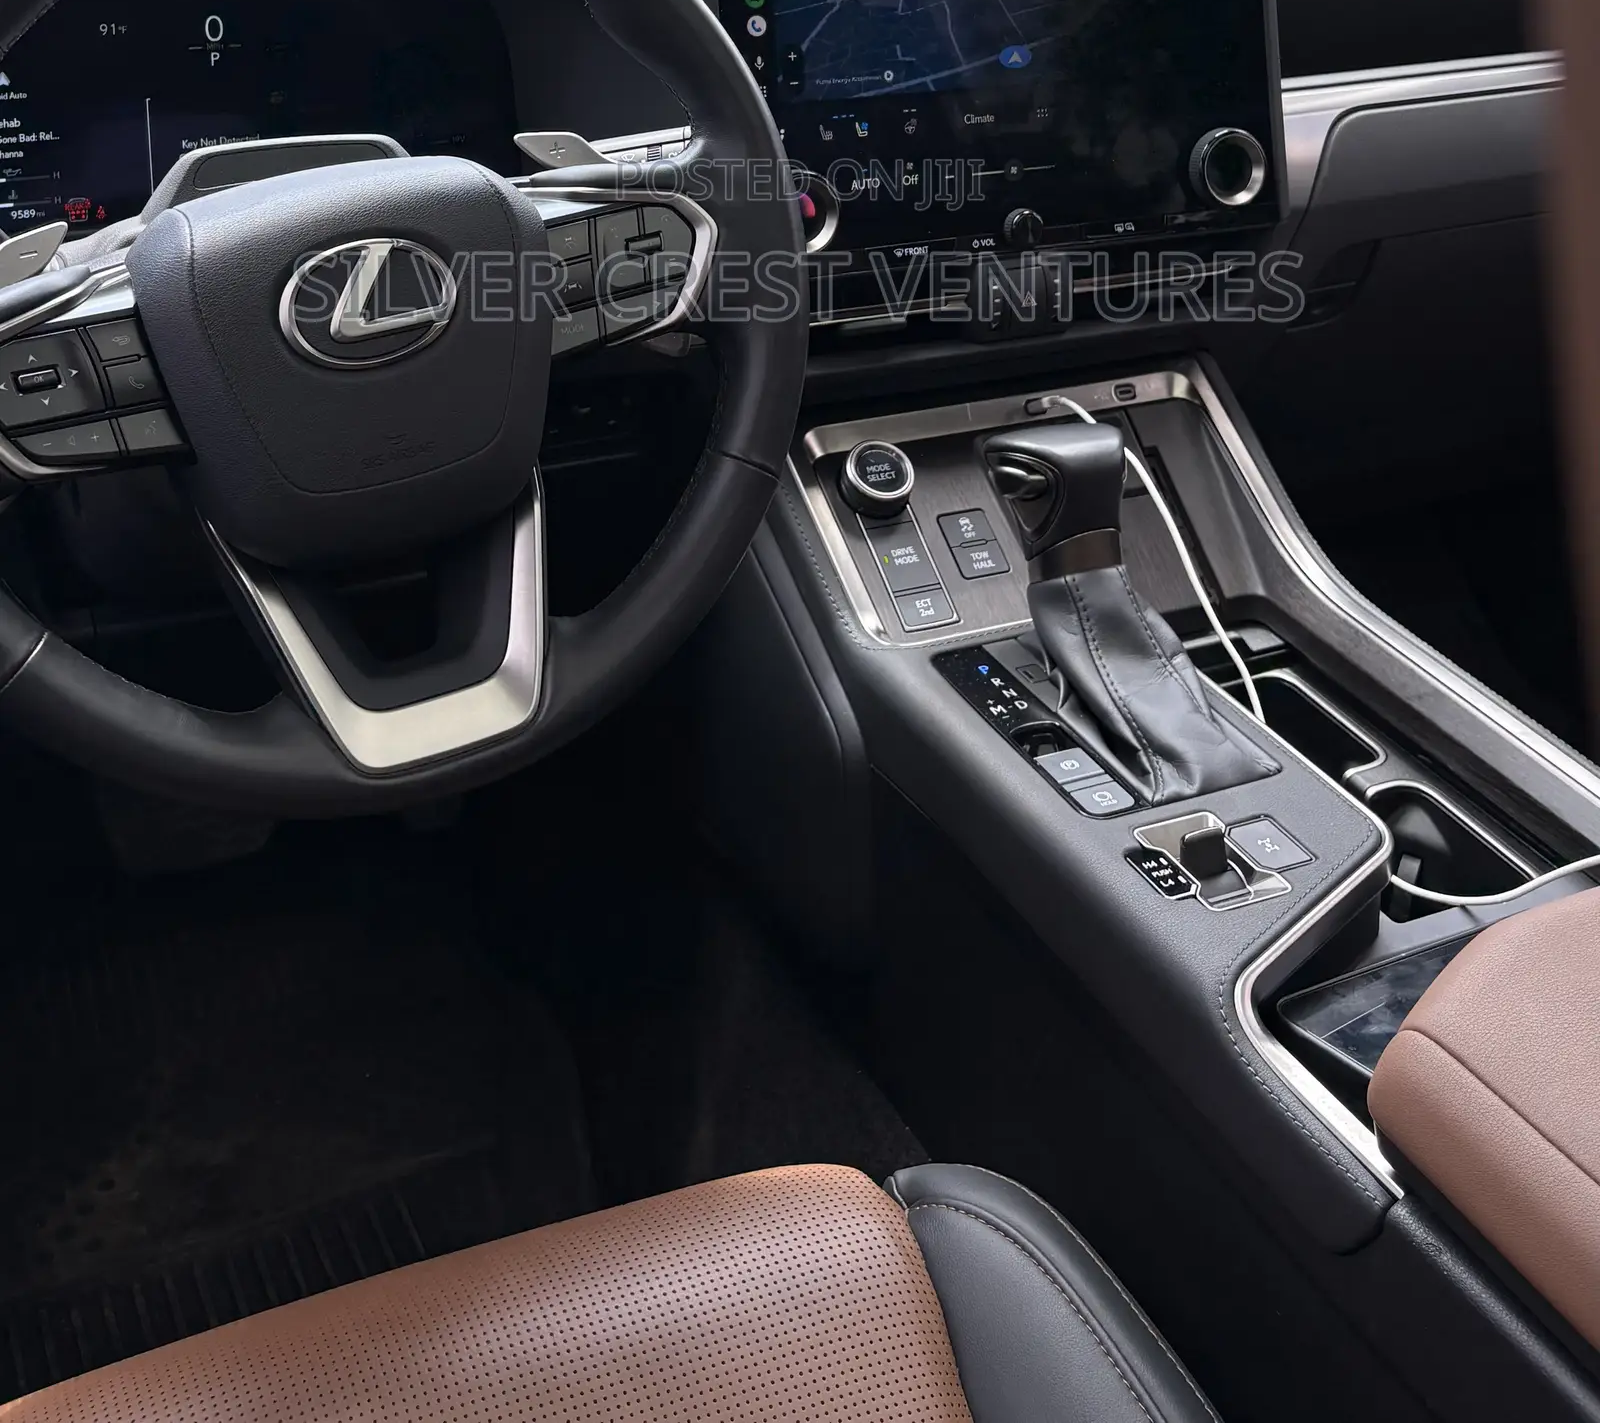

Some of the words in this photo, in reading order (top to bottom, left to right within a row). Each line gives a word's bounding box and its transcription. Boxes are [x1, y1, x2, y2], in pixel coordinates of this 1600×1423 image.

[205, 15, 223, 42] 0
[210, 52, 220, 66] P
[9, 91, 27, 100] Auto
[964, 114, 995, 125] Climate
[19, 133, 38, 143] Bad:
[182, 139, 198, 150] Key
[200, 137, 217, 148] Not
[851, 178, 880, 191] AUTO
[902, 175, 919, 186] Off
[10, 209, 36, 220] 9589
[980, 238, 996, 247] VOL
[904, 245, 929, 256] FRONT
[33, 375, 45, 384] OK
[866, 463, 891, 473] MODE
[867, 471, 896, 483] SELECT
[964, 531, 976, 539] OFF
[890, 546, 916, 558] DRIVE
[970, 551, 989, 561] TOW
[894, 554, 920, 566] MODE
[972, 558, 996, 570] HAUL
[915, 598, 932, 608] ECT
[918, 606, 935, 617] 2nd
[990, 677, 1005, 687] R
[1002, 688, 1018, 699] N
[989, 704, 1008, 716] M
[1014, 700, 1028, 710] D
[1100, 798, 1118, 807] HOLD
[1141, 857, 1158, 870] H4
[1151, 867, 1174, 879] PUSH
[1160, 880, 1176, 888] L4
